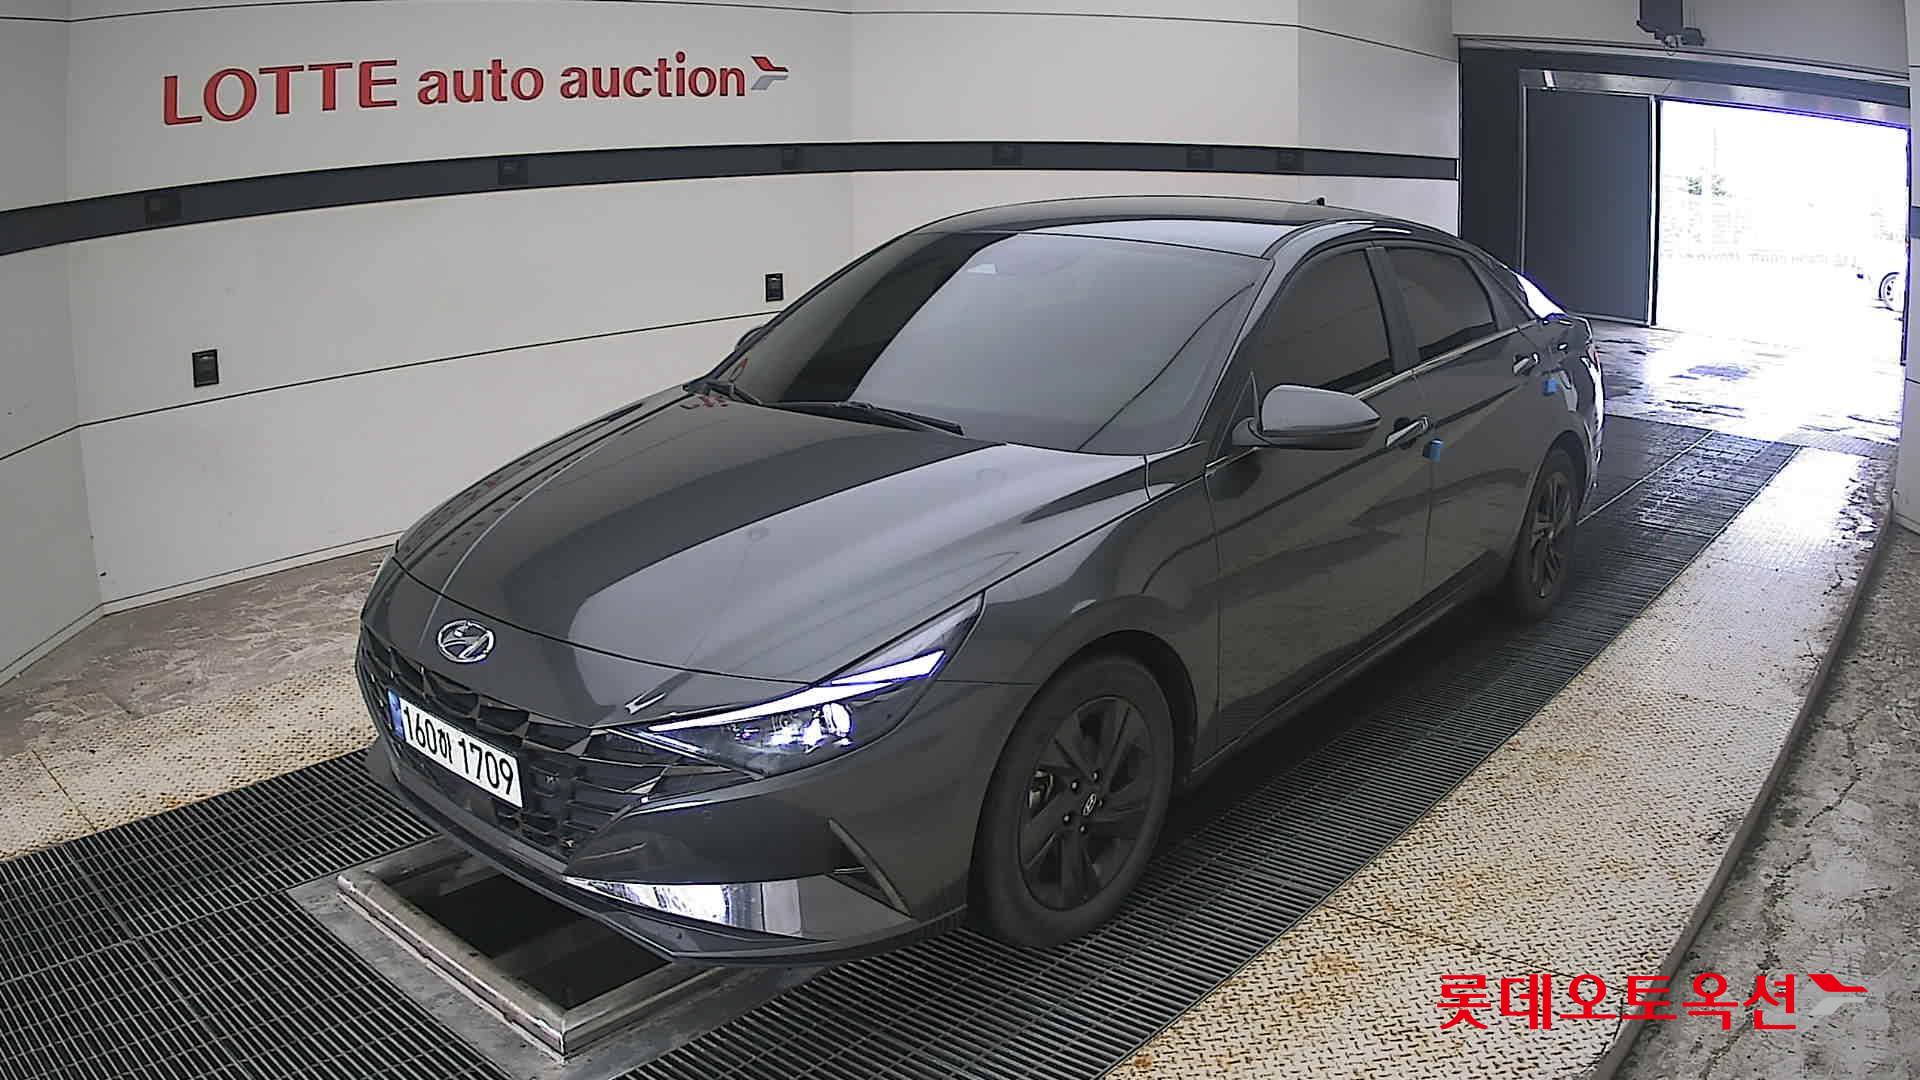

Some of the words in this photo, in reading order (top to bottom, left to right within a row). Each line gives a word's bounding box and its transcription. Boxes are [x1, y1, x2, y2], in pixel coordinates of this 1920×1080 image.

[163, 59, 398, 126] LOTTE
[417, 58, 545, 105] auto
[559, 50, 748, 98] auction
[458, 738, 514, 795] 1709
